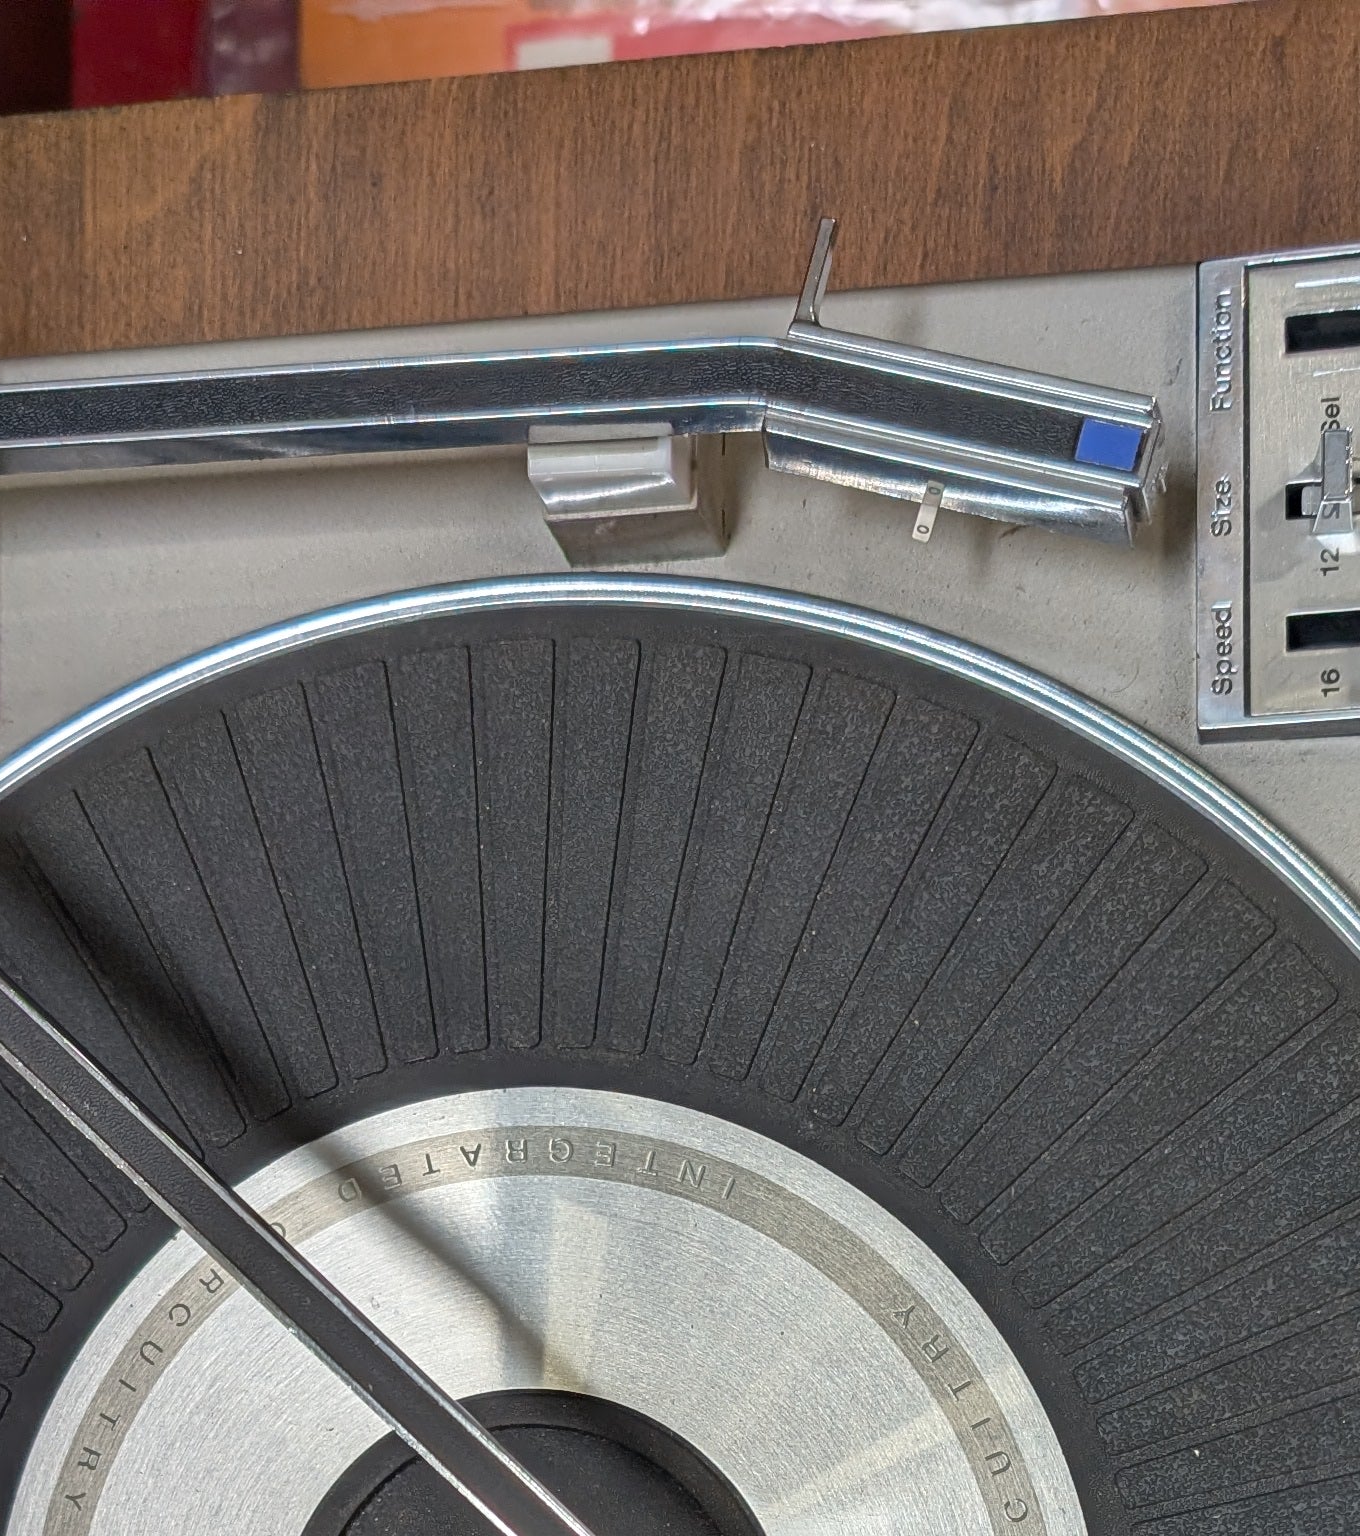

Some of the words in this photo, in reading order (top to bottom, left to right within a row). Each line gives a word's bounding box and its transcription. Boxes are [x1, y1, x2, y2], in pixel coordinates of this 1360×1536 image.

[1209, 289, 1232, 412] Function
[1211, 479, 1233, 537] Size
[1320, 546, 1340, 577] 12
[1211, 600, 1233, 695] Speed
[1321, 667, 1340, 697] 16
[339, 1136, 737, 1202] INTEGRATED
